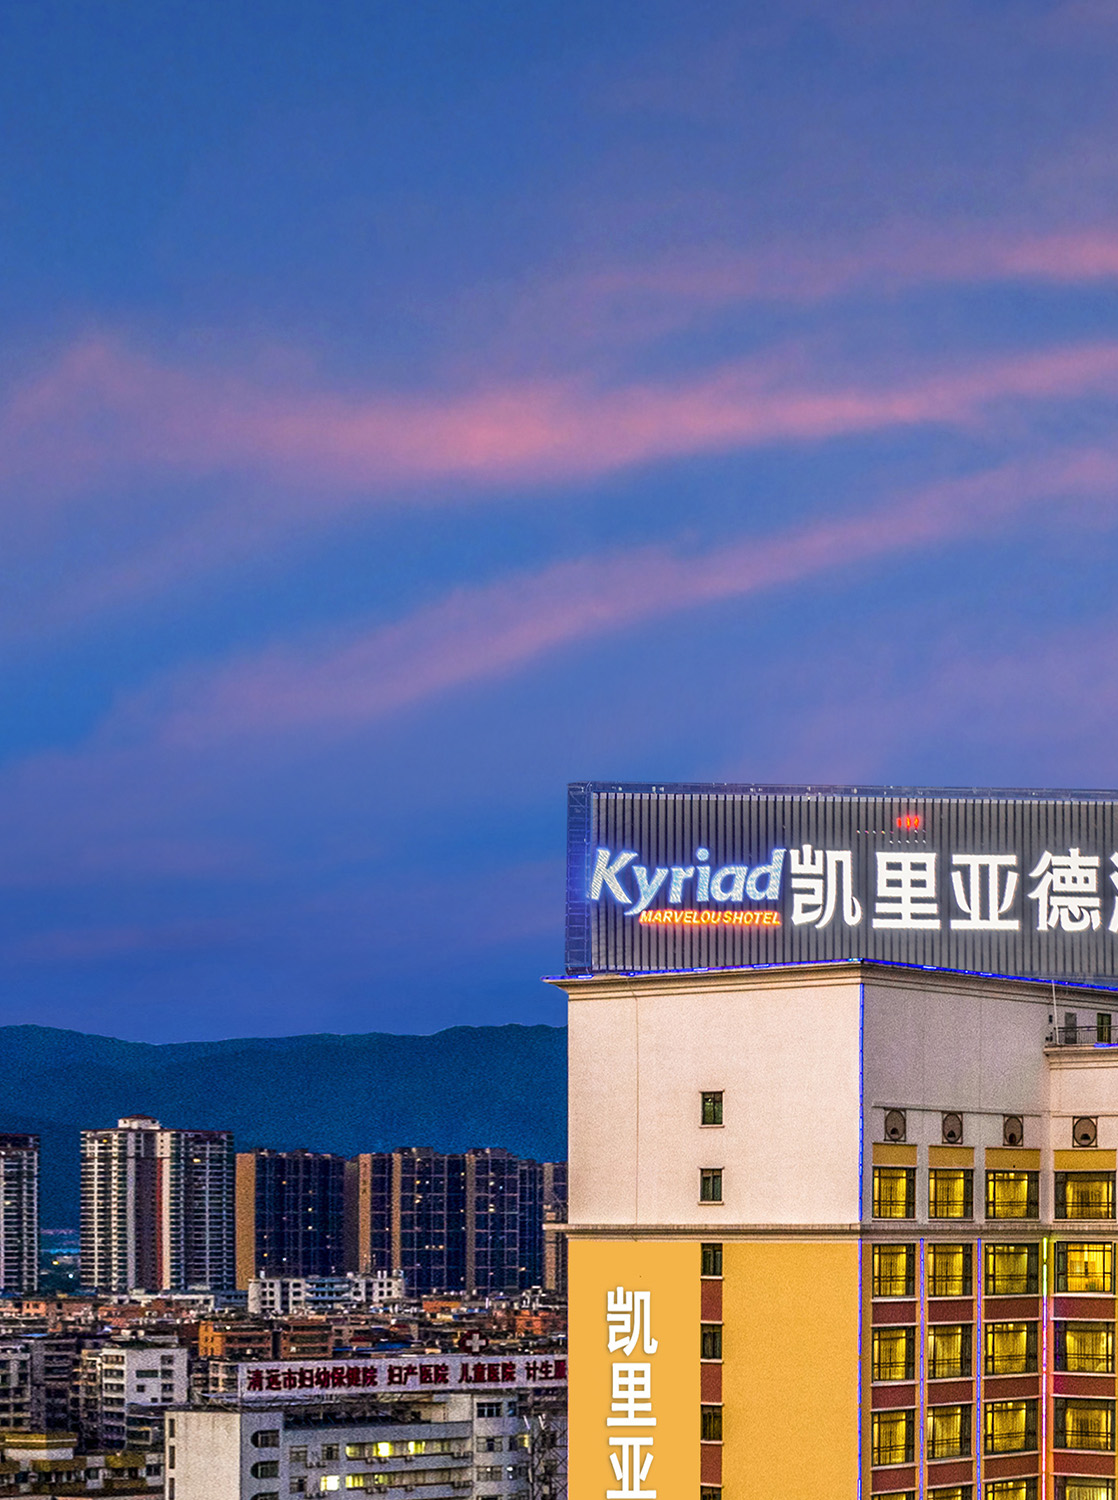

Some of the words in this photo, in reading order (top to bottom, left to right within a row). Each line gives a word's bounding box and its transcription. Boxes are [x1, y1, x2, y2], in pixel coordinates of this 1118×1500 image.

[587, 847, 787, 916] Kyriad
[246, 1364, 379, 1391] 清远市妇幼保健院
[387, 1362, 449, 1385] 妇产医院
[458, 1360, 517, 1383] 儿童医院
